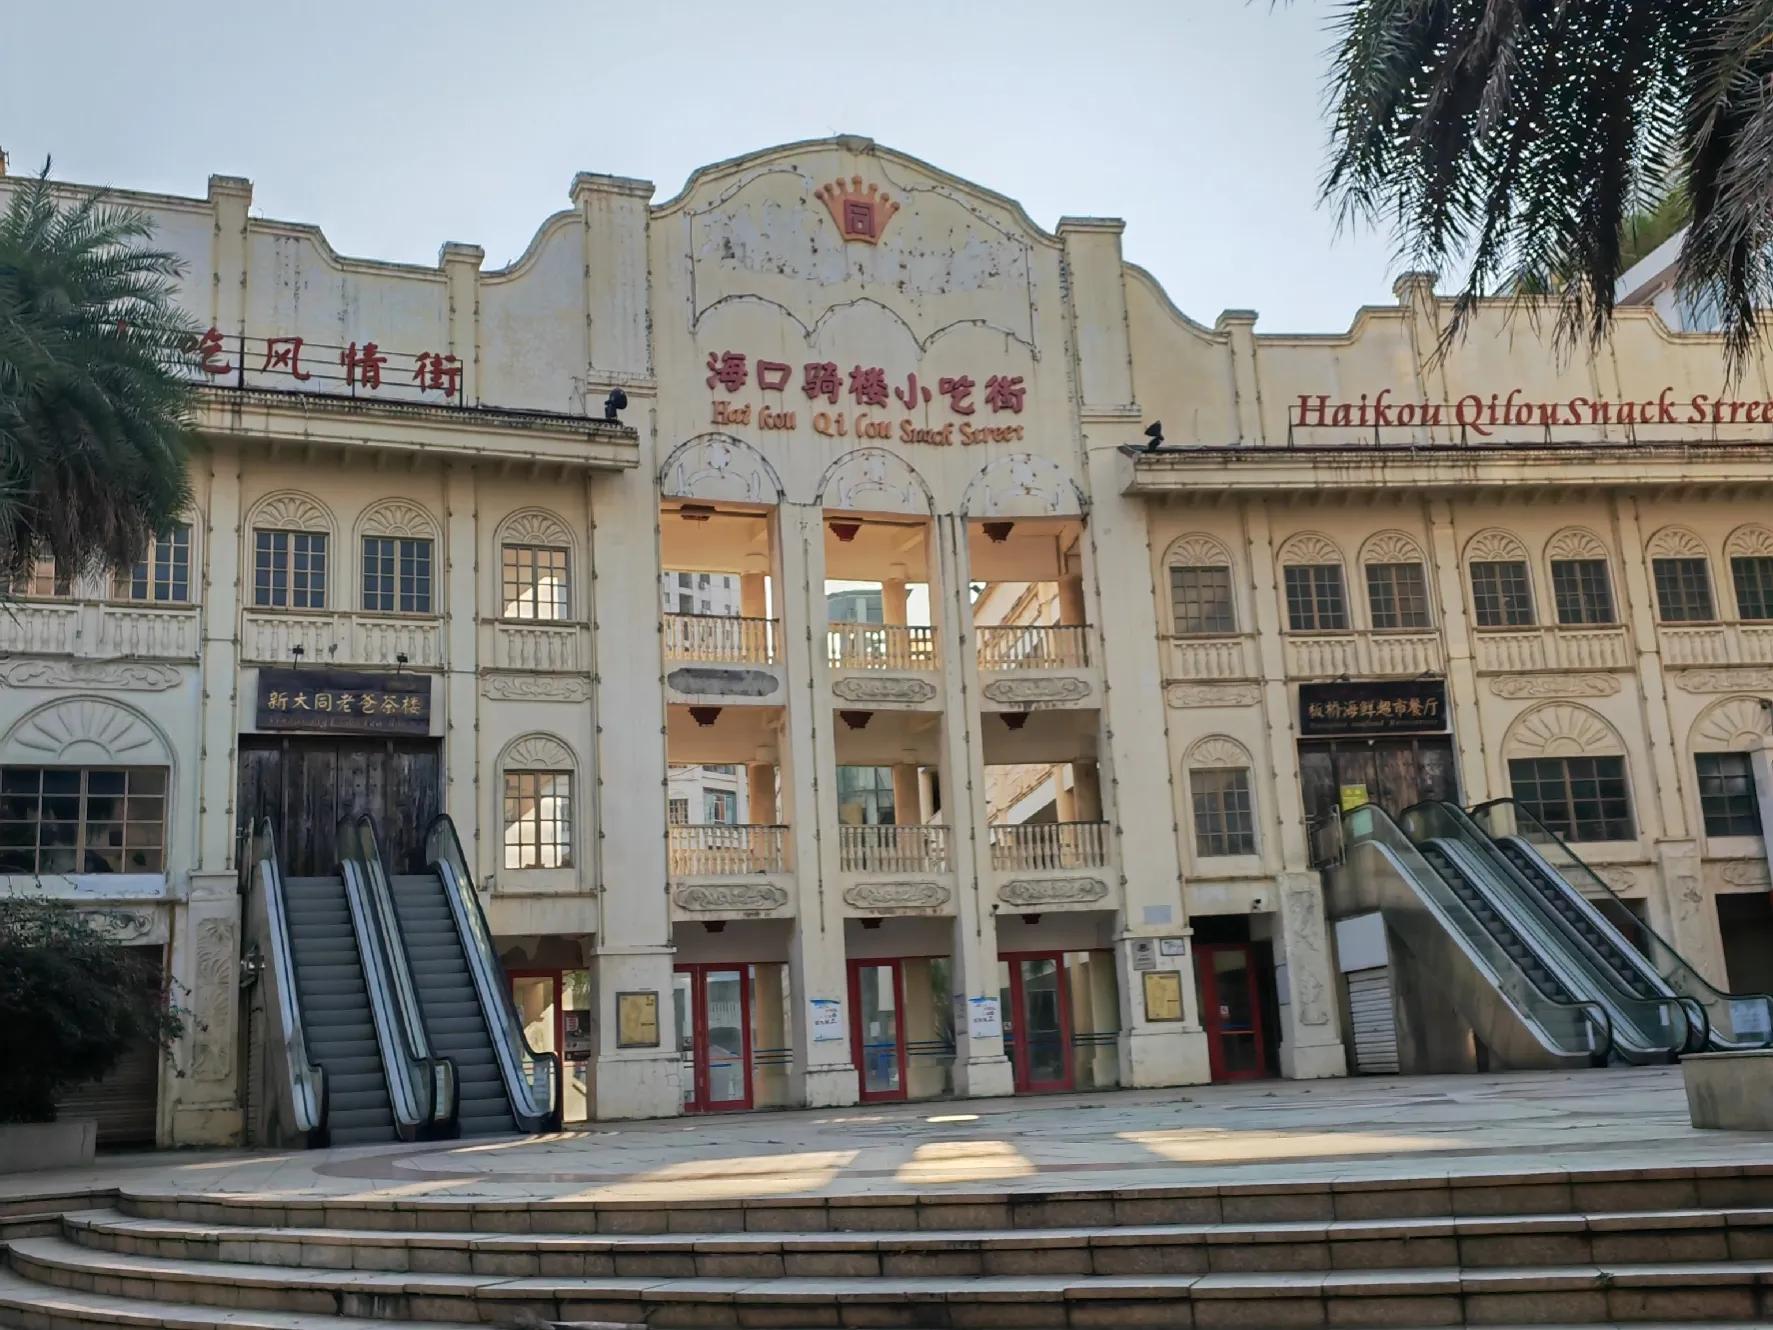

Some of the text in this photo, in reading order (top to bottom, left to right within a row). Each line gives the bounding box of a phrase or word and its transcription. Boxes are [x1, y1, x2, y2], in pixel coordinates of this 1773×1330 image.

[116, 319, 463, 398] 吃风情街
[706, 350, 1027, 416] 海口骑楼小吃街
[711, 400, 751, 425] Hai
[813, 412, 848, 437] Qi
[900, 419, 954, 446] Snack
[959, 421, 1025, 446] Street
[1297, 388, 1442, 427] Haikou
[1455, 388, 1560, 436] Qilou
[267, 690, 423, 715] 新大同老爸茶楼
[1308, 696, 1439, 719] 板桥海鲜超市餐厅
